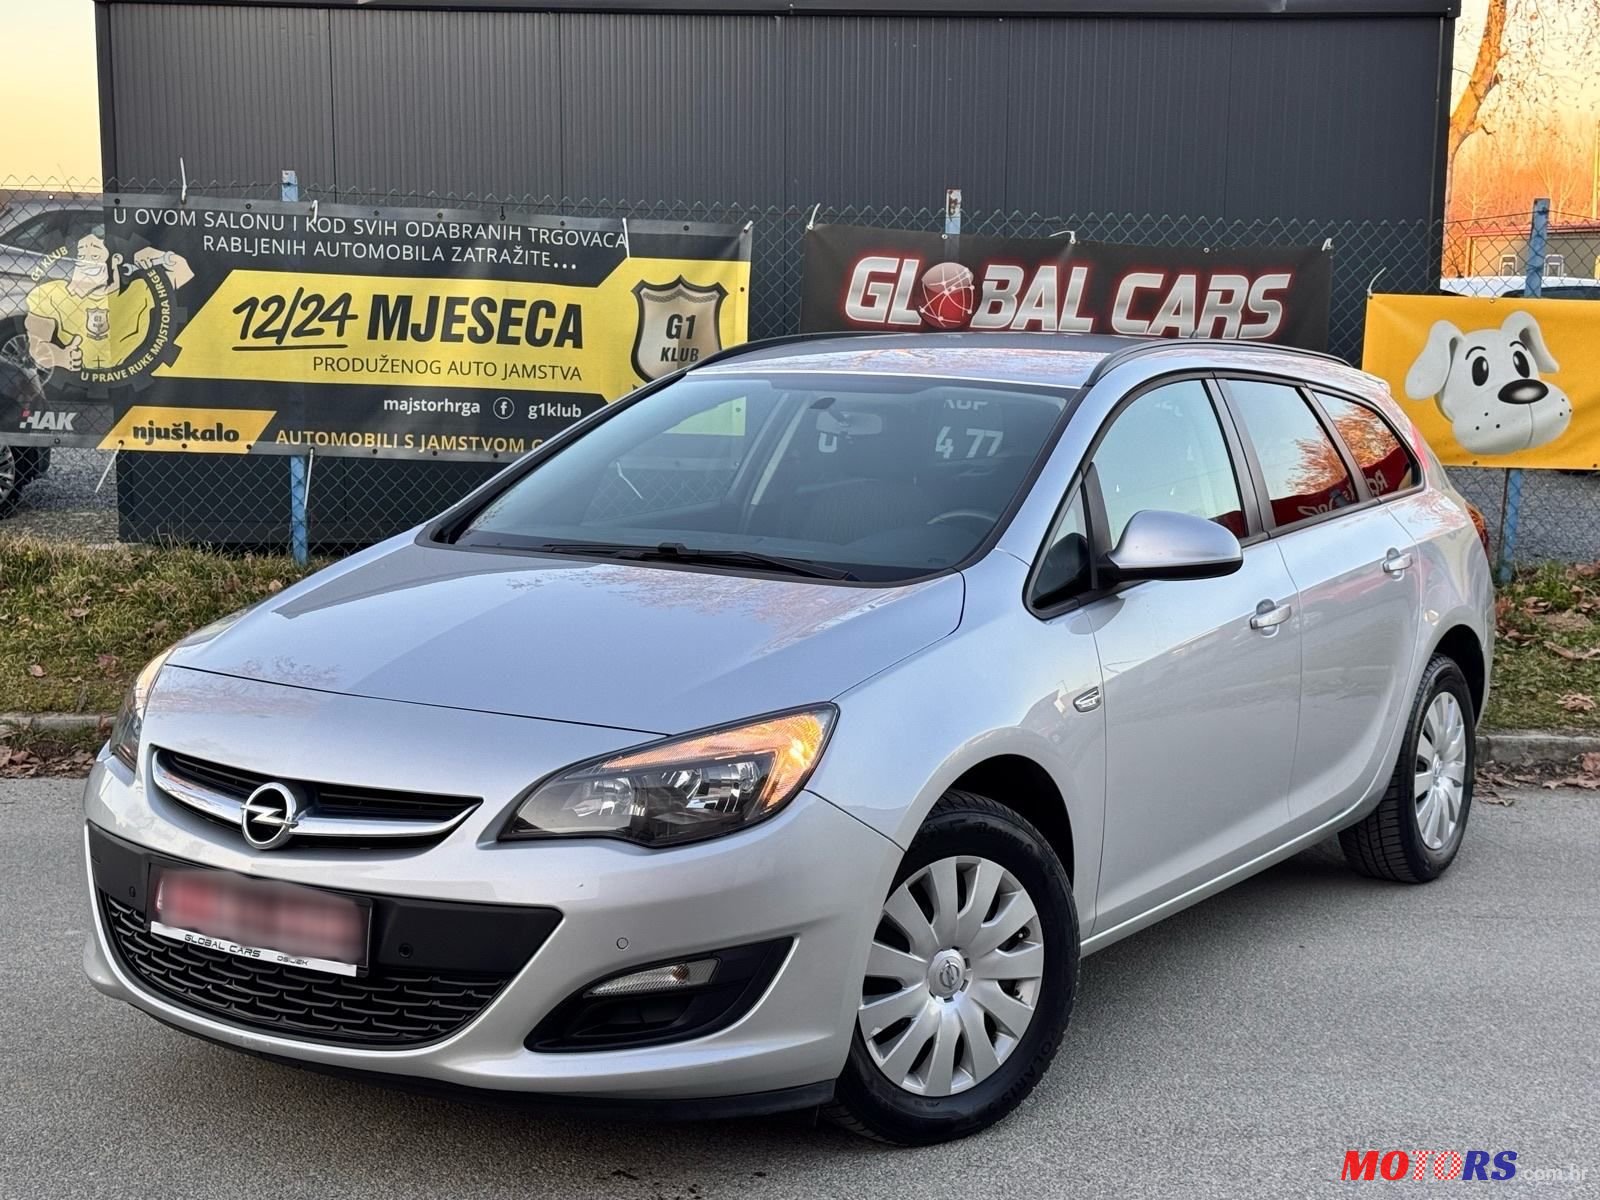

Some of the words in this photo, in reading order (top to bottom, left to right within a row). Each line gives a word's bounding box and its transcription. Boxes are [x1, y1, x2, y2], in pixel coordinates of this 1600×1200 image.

[113, 208, 127, 224] U
[135, 209, 196, 226] OVOM
[204, 212, 284, 231] SALONU
[293, 216, 297, 231] I
[306, 216, 346, 234] KOD
[354, 219, 397, 236] SVIH
[405, 221, 521, 242] ODABRANIH
[528, 227, 627, 249] TRGOVACA
[40, 246, 69, 268] KLUB
[203, 235, 305, 257] RABLJENIH
[313, 241, 445, 262] AUTOMOBILA
[147, 269, 168, 298] HRGE
[844, 256, 1093, 333] GLOBAL
[1111, 272, 1291, 340] CARS
[149, 299, 171, 356] MAJSTORA
[232, 286, 359, 345] 12/24
[367, 294, 583, 350] MJESECA
[666, 313, 696, 340] G1
[128, 352, 154, 375] RUKE
[660, 346, 700, 362] KLUB
[80, 371, 89, 381] U
[92, 370, 128, 382] PRAVE
[313, 354, 441, 375] PRODUŽENOG
[447, 360, 497, 377] AUTO
[501, 362, 582, 381] JAMSTVA
[383, 397, 481, 417] majstorhrga
[527, 402, 582, 419] g1klub
[132, 420, 240, 446] njuškalo
[275, 430, 398, 449] AUTOMOBILI
[405, 434, 415, 449] S
[419, 434, 525, 453] JAMSTVOM
[185, 934, 226, 951] GLOBAL
[229, 944, 262, 958] CARS
